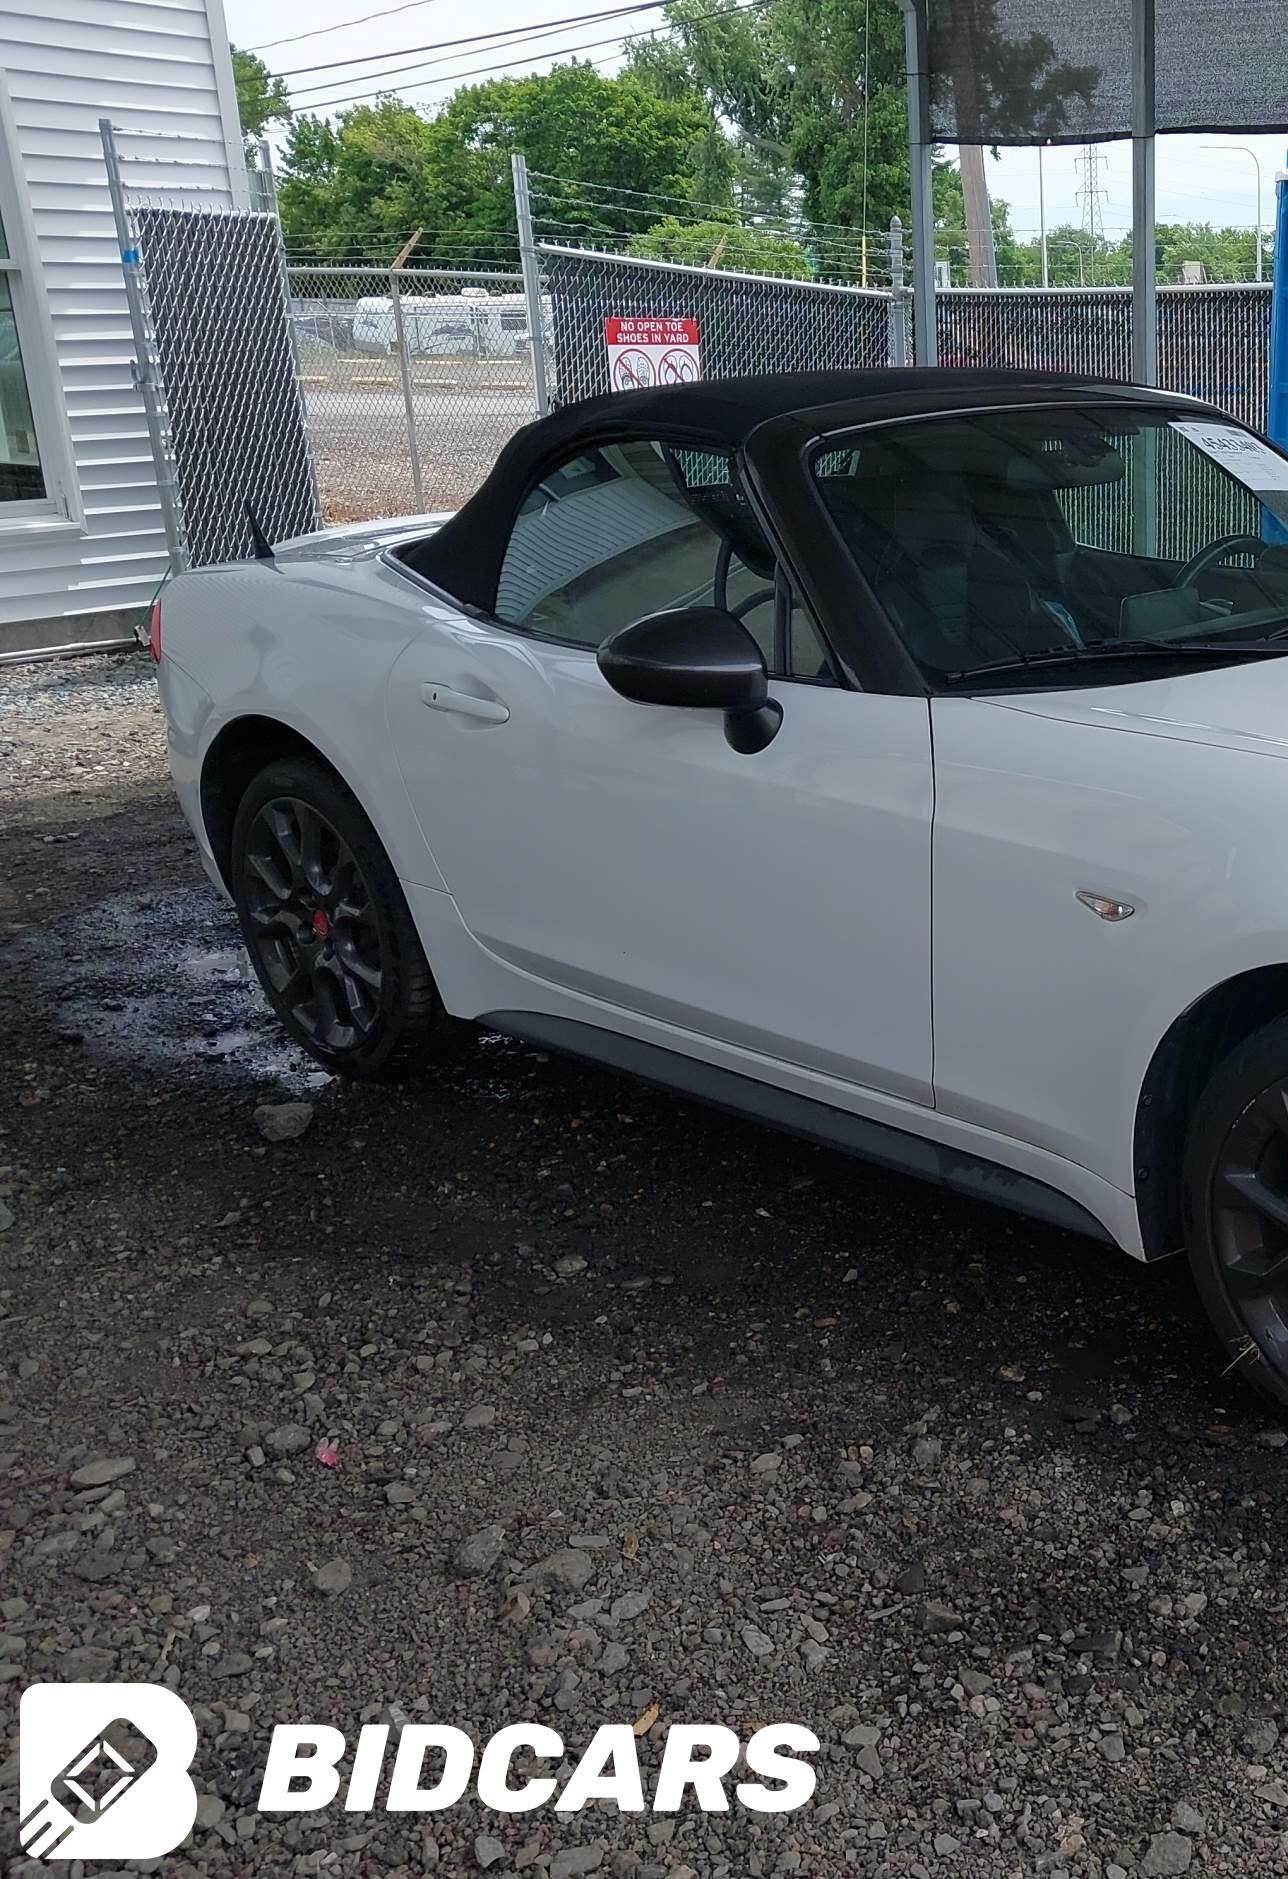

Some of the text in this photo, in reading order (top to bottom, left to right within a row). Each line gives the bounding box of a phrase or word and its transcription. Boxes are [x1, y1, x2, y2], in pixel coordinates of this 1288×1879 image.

[620, 322, 684, 331] NO OPEN TOE
[616, 333, 689, 343] SHOES IN YARD
